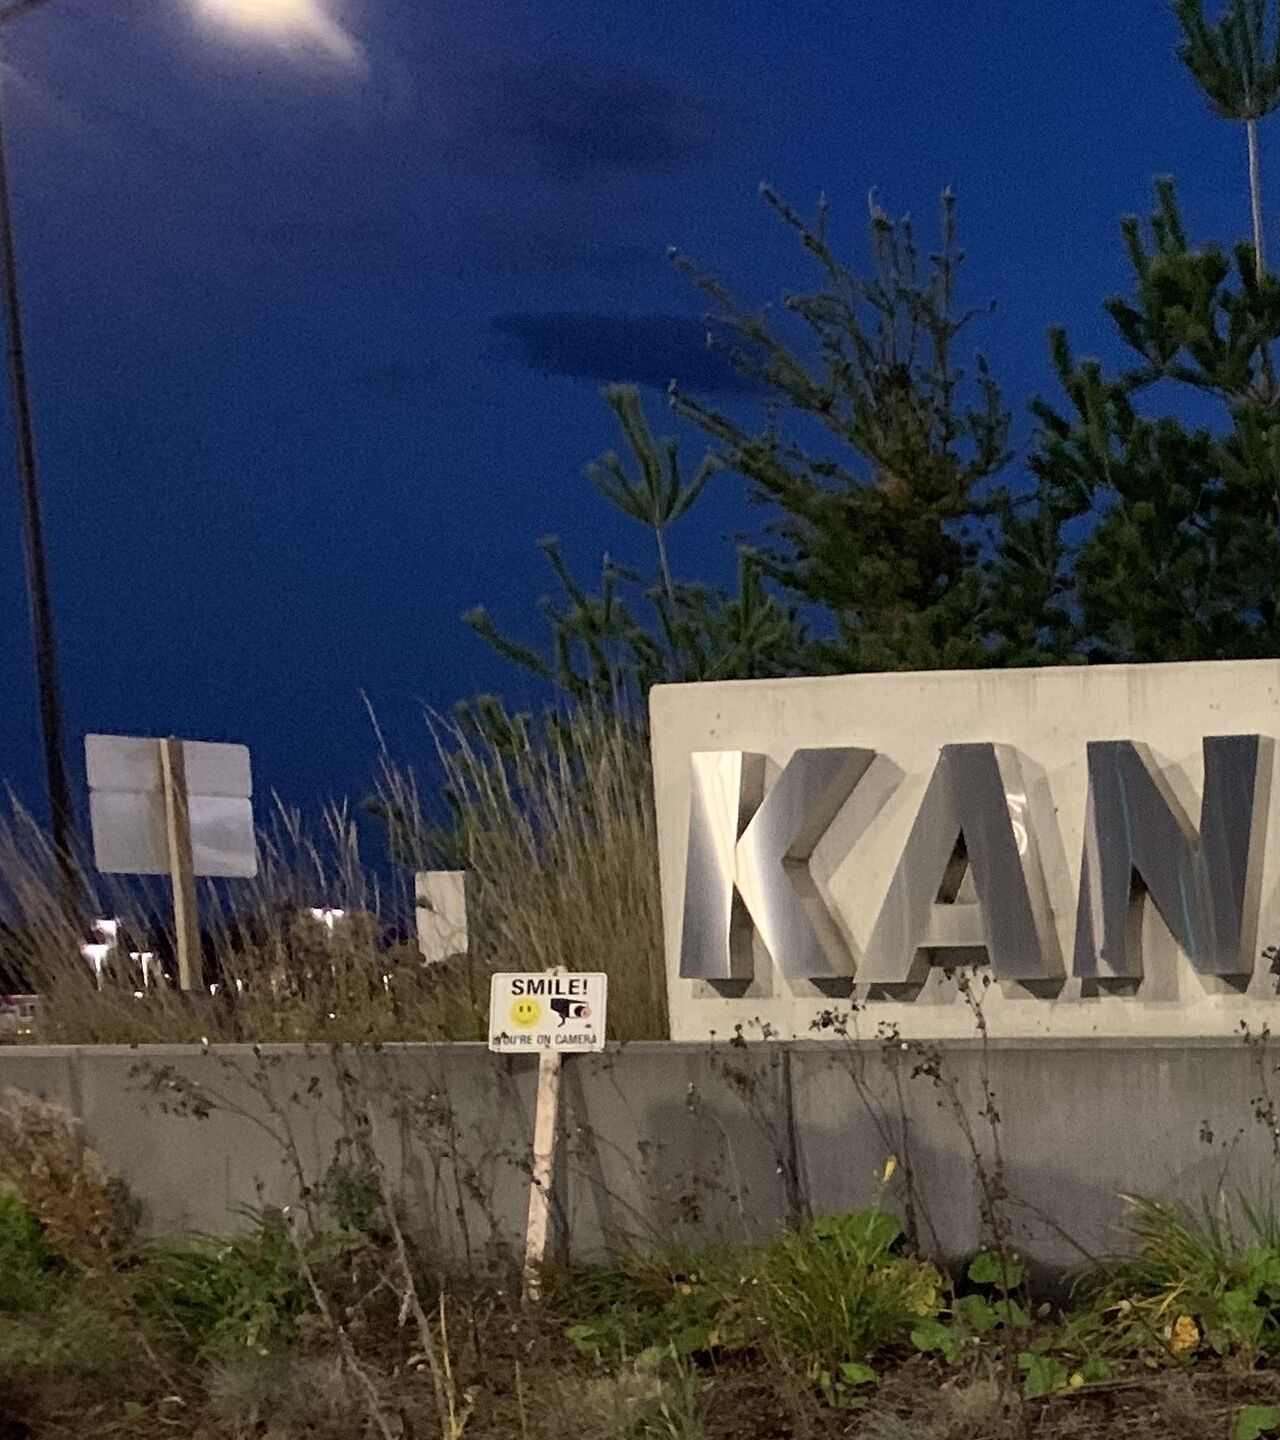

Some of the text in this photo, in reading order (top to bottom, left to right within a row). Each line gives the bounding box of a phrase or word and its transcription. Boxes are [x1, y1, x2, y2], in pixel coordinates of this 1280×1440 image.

[511, 979, 588, 996] SMILE!
[537, 1034, 551, 1045] ON
[555, 1034, 597, 1045] CAMERA
